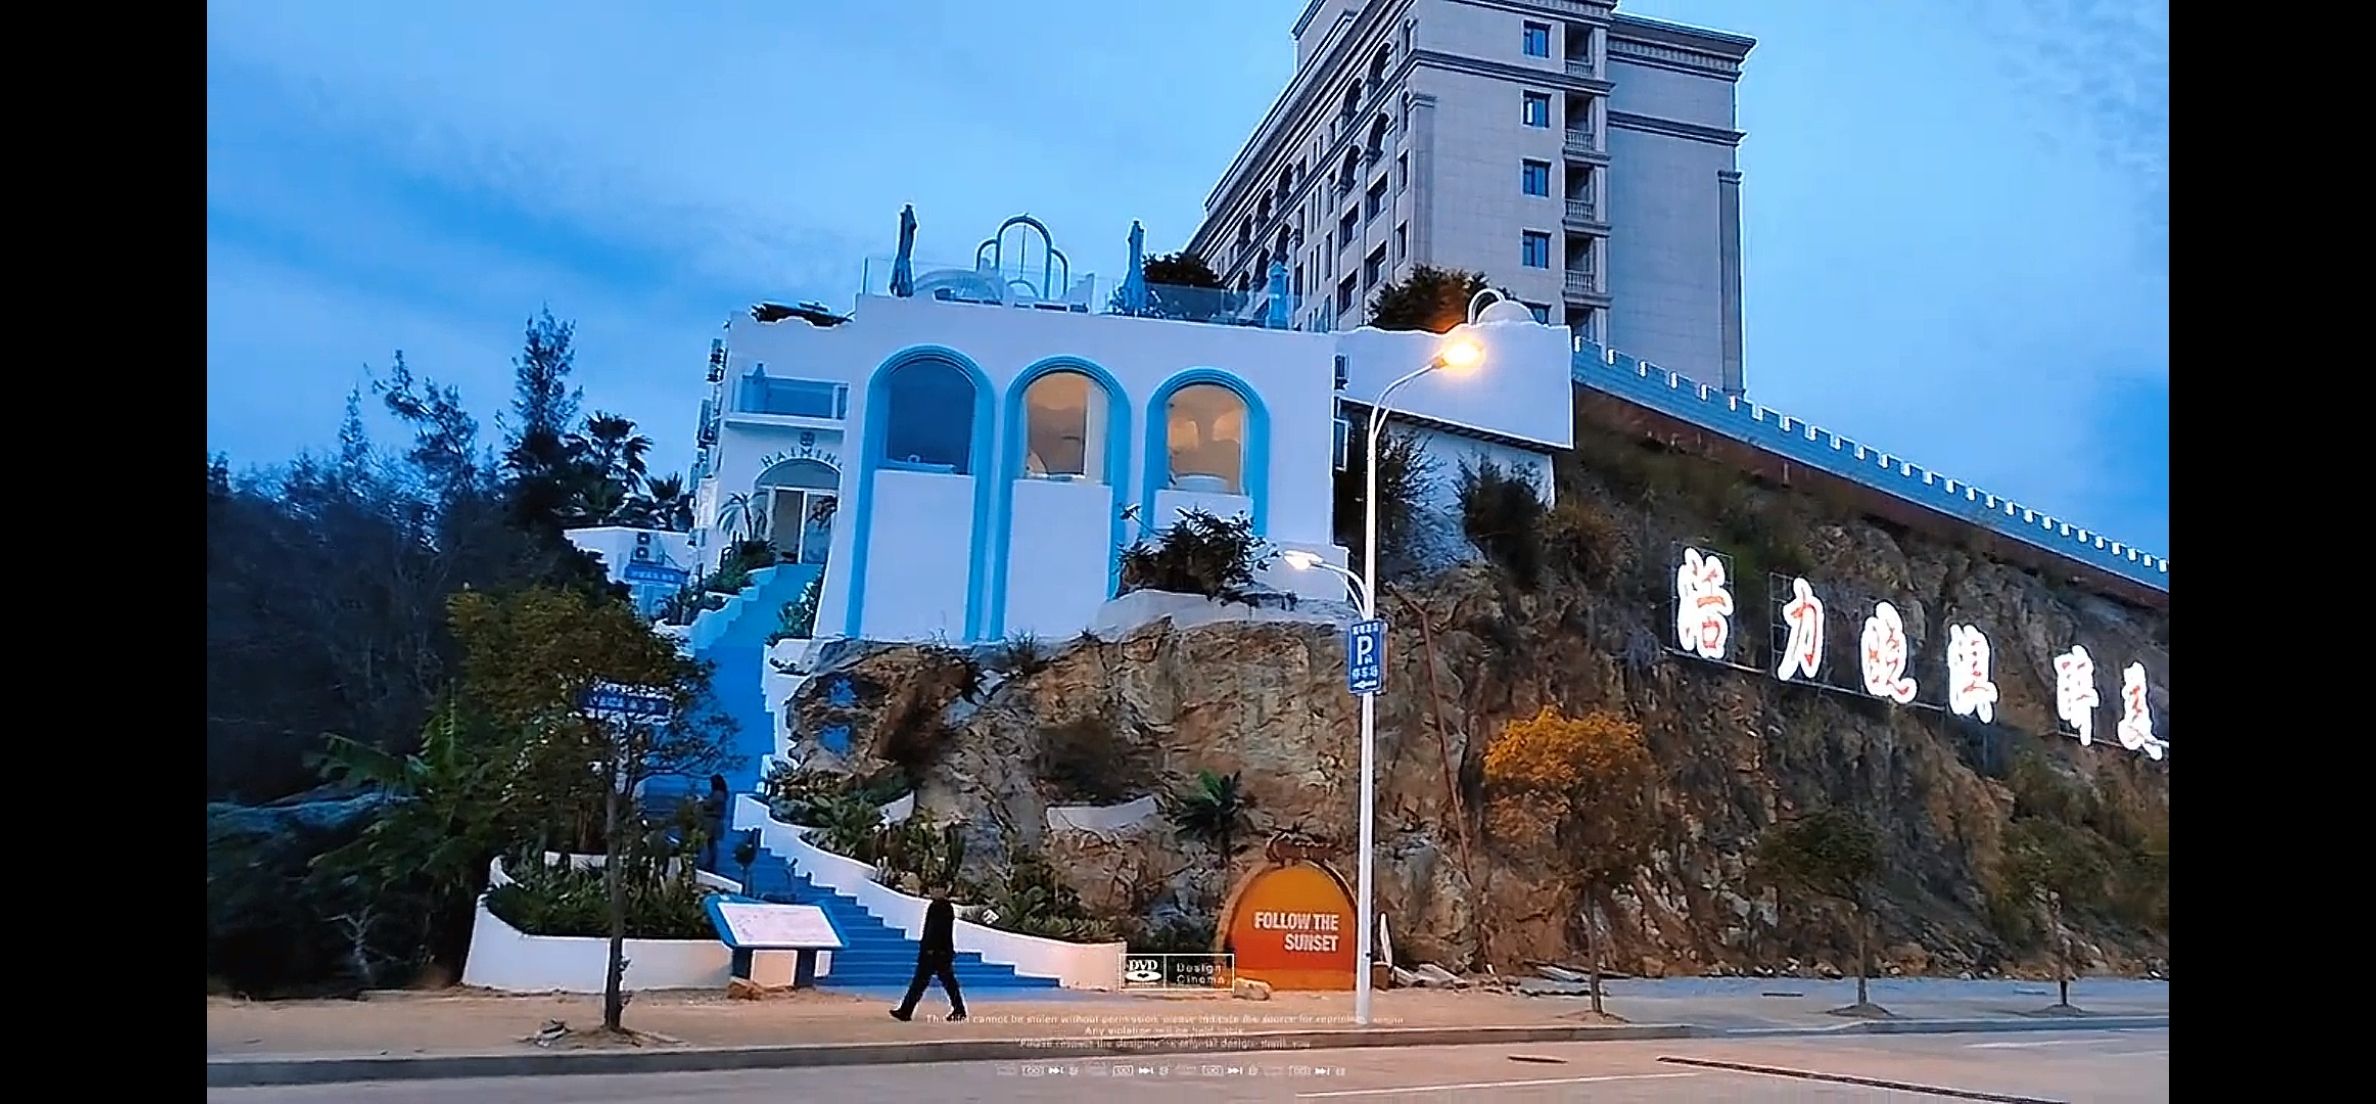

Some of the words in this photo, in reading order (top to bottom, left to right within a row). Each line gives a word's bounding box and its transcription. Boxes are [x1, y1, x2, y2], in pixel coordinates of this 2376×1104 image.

[1357, 635, 1373, 665] P
[1254, 912, 1311, 930] FOLLOW
[1312, 914, 1339, 931] THE
[1284, 933, 1339, 952] SUNSET
